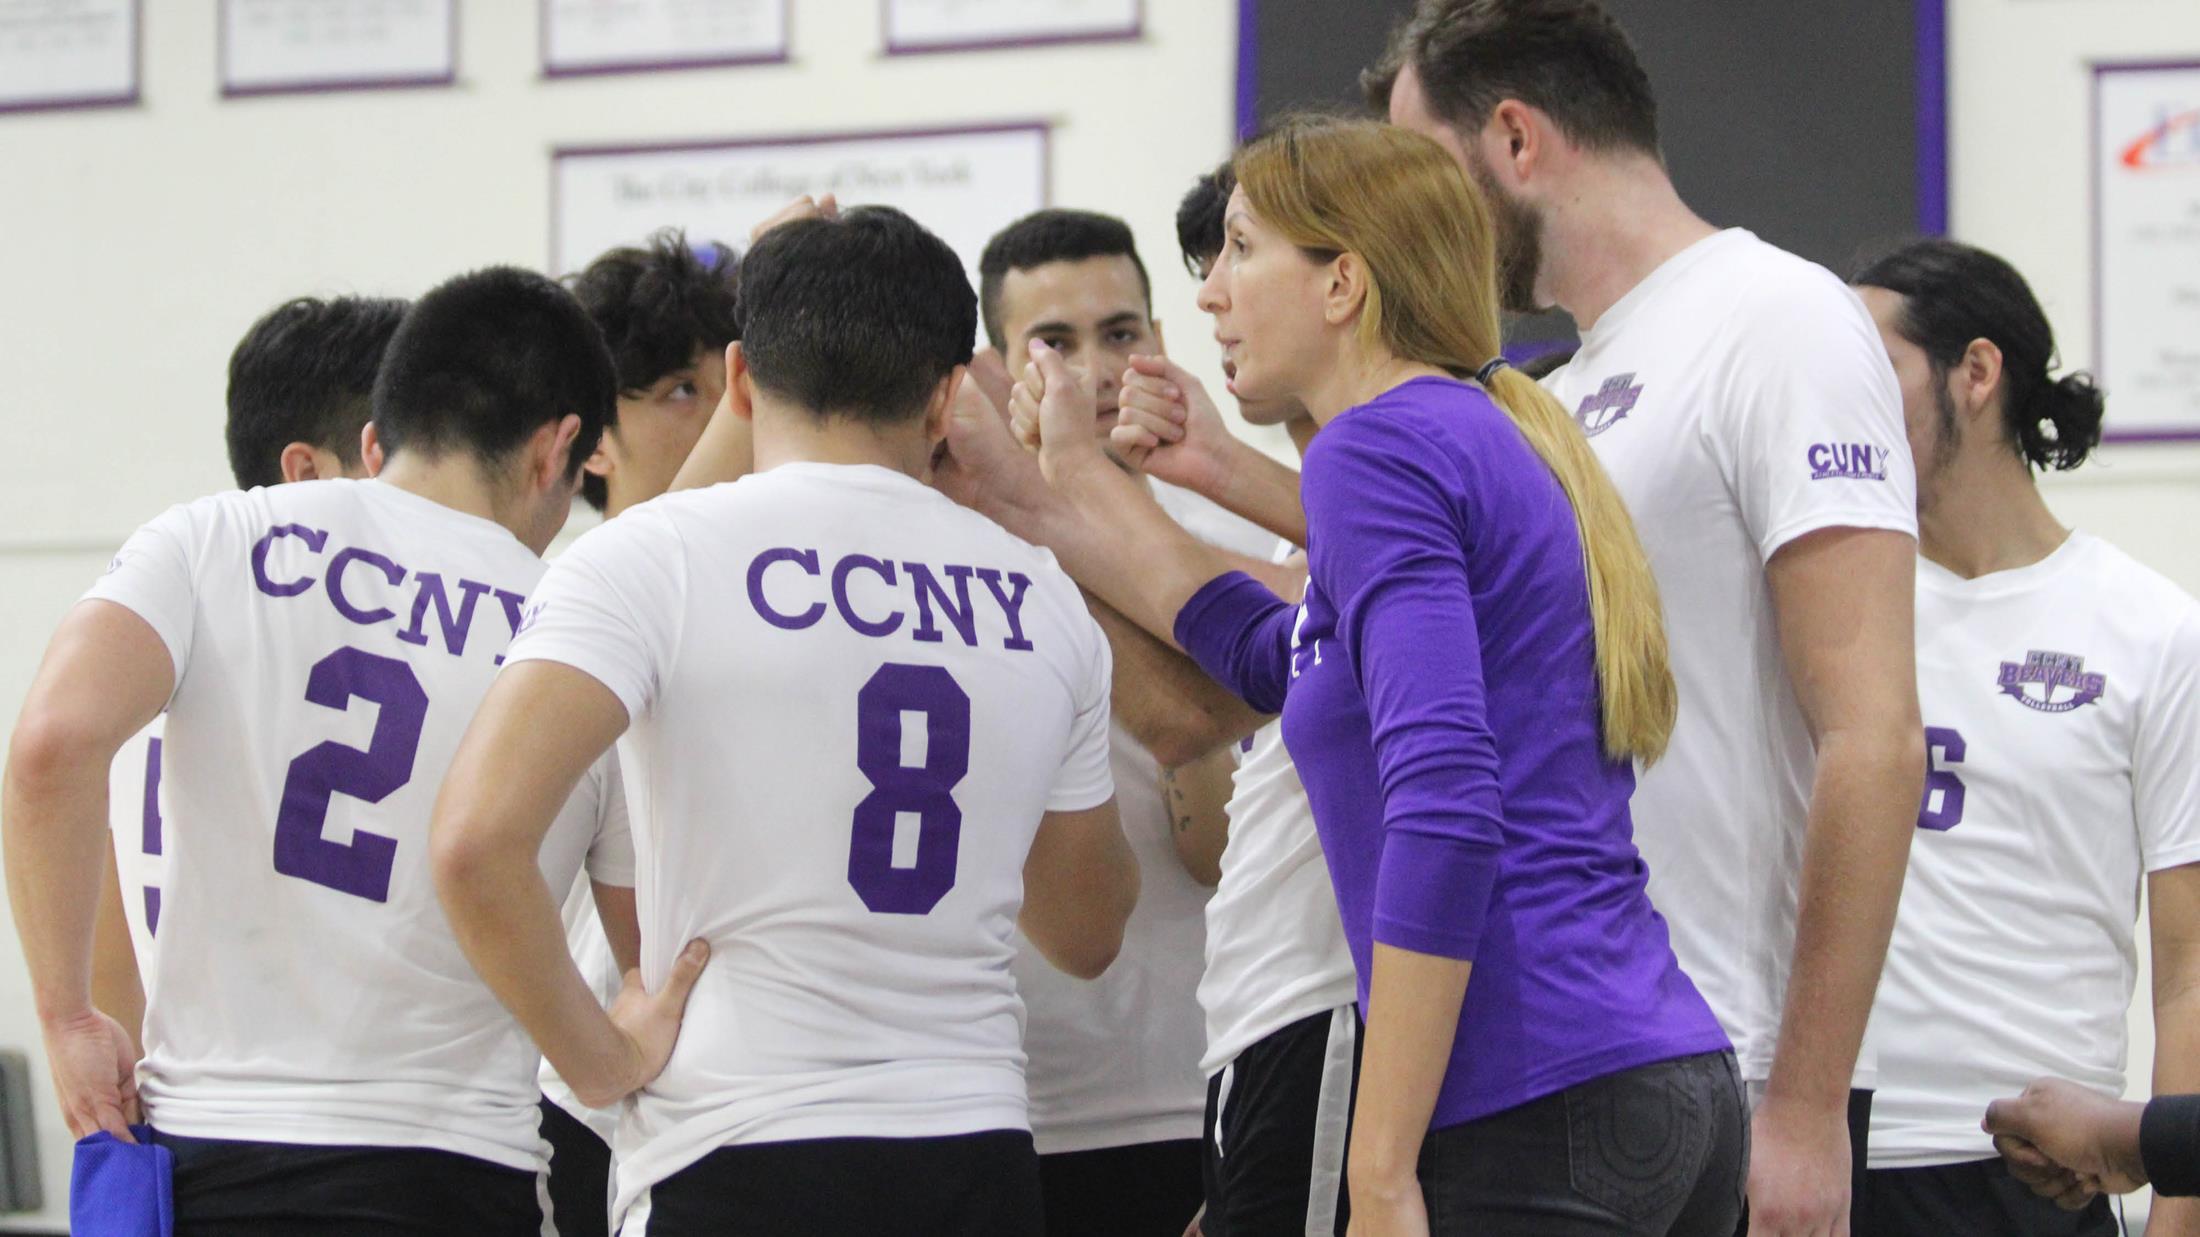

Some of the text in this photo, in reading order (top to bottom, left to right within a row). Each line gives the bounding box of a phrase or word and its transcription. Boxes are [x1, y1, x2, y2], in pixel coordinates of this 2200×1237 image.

[1808, 443, 1890, 474] CUNY
[747, 547, 1033, 651] CCNY
[1998, 661, 2106, 703] BEAVERS
[274, 645, 429, 903] 2
[848, 662, 970, 914] 8
[1916, 726, 1966, 831] 6
